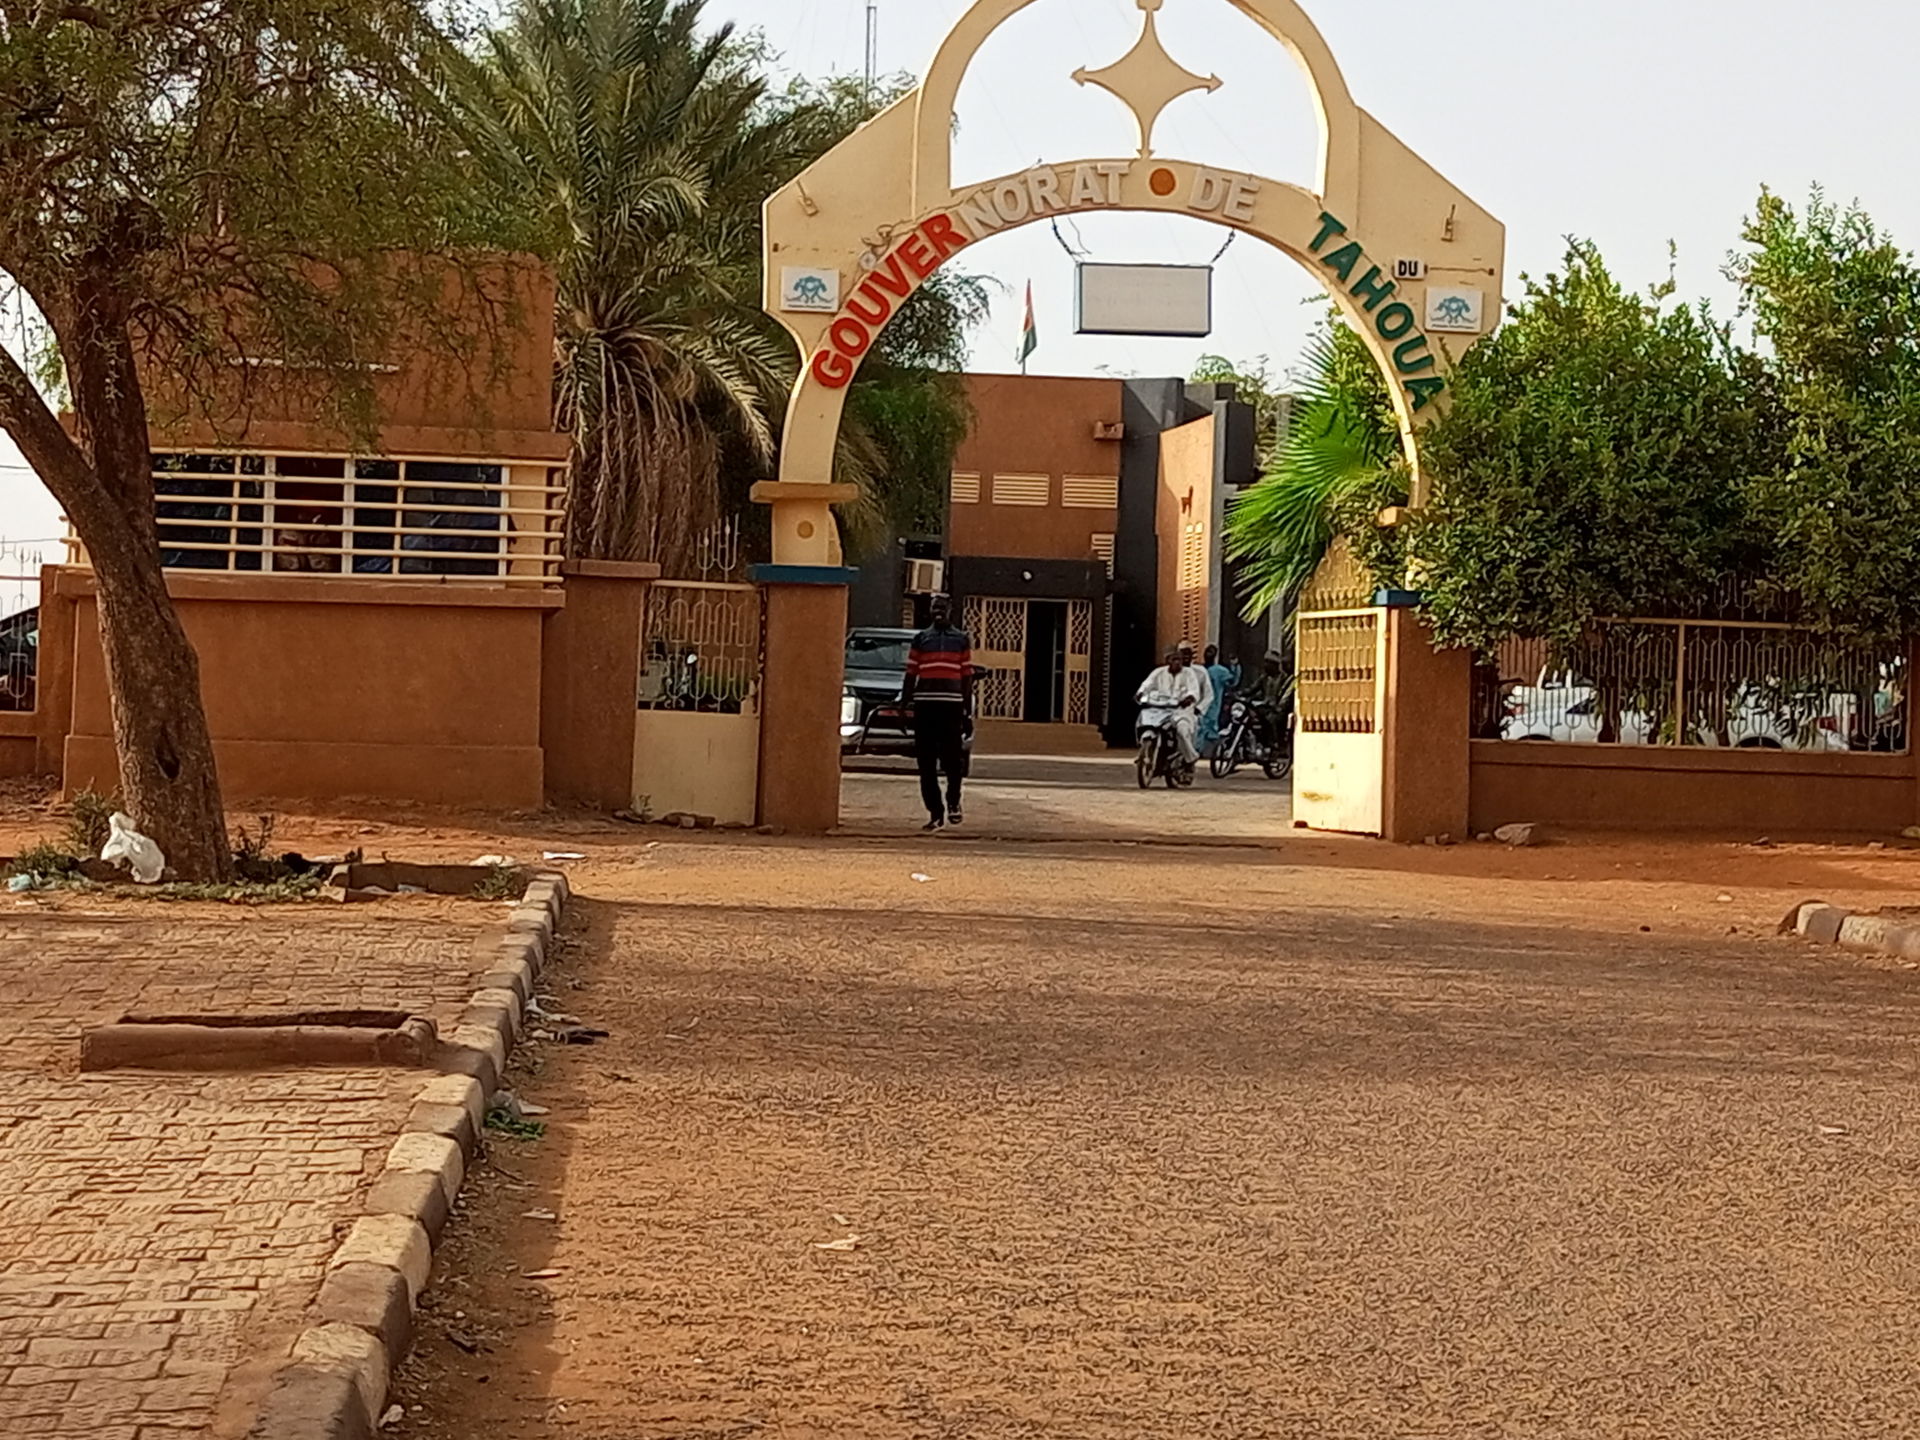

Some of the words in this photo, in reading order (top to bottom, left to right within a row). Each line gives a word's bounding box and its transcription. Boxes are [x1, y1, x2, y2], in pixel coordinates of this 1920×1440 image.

[812, 161, 1129, 389] GOUVERNORAT
[1187, 167, 1261, 223] DE
[1307, 211, 1445, 412] TAHOUA
[1398, 260, 1418, 277] DU
